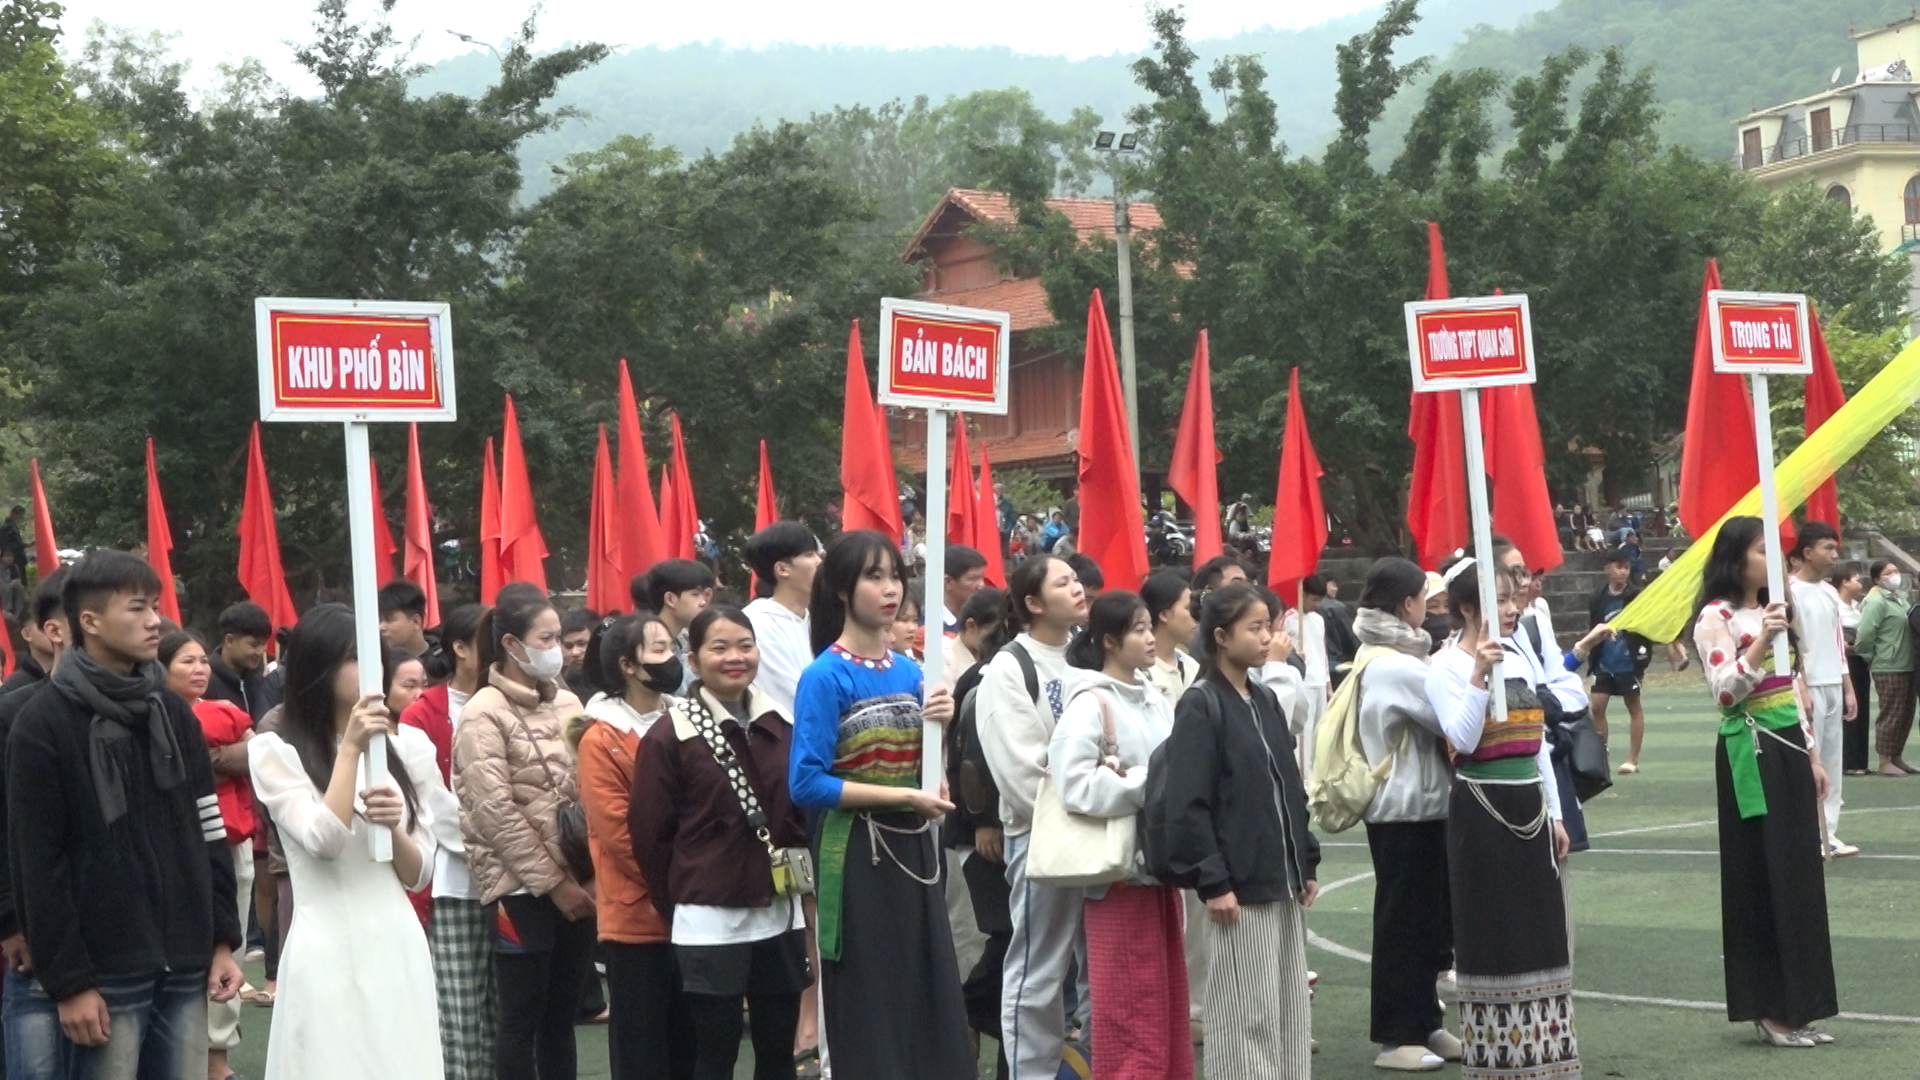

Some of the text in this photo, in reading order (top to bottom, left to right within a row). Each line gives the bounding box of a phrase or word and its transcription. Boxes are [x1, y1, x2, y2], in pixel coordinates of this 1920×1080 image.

[288, 333, 425, 391] KHU PHỐ BÌN
[901, 327, 987, 380] BẢN BÁCH
[1729, 317, 1792, 354] TRỌNG TÀI
